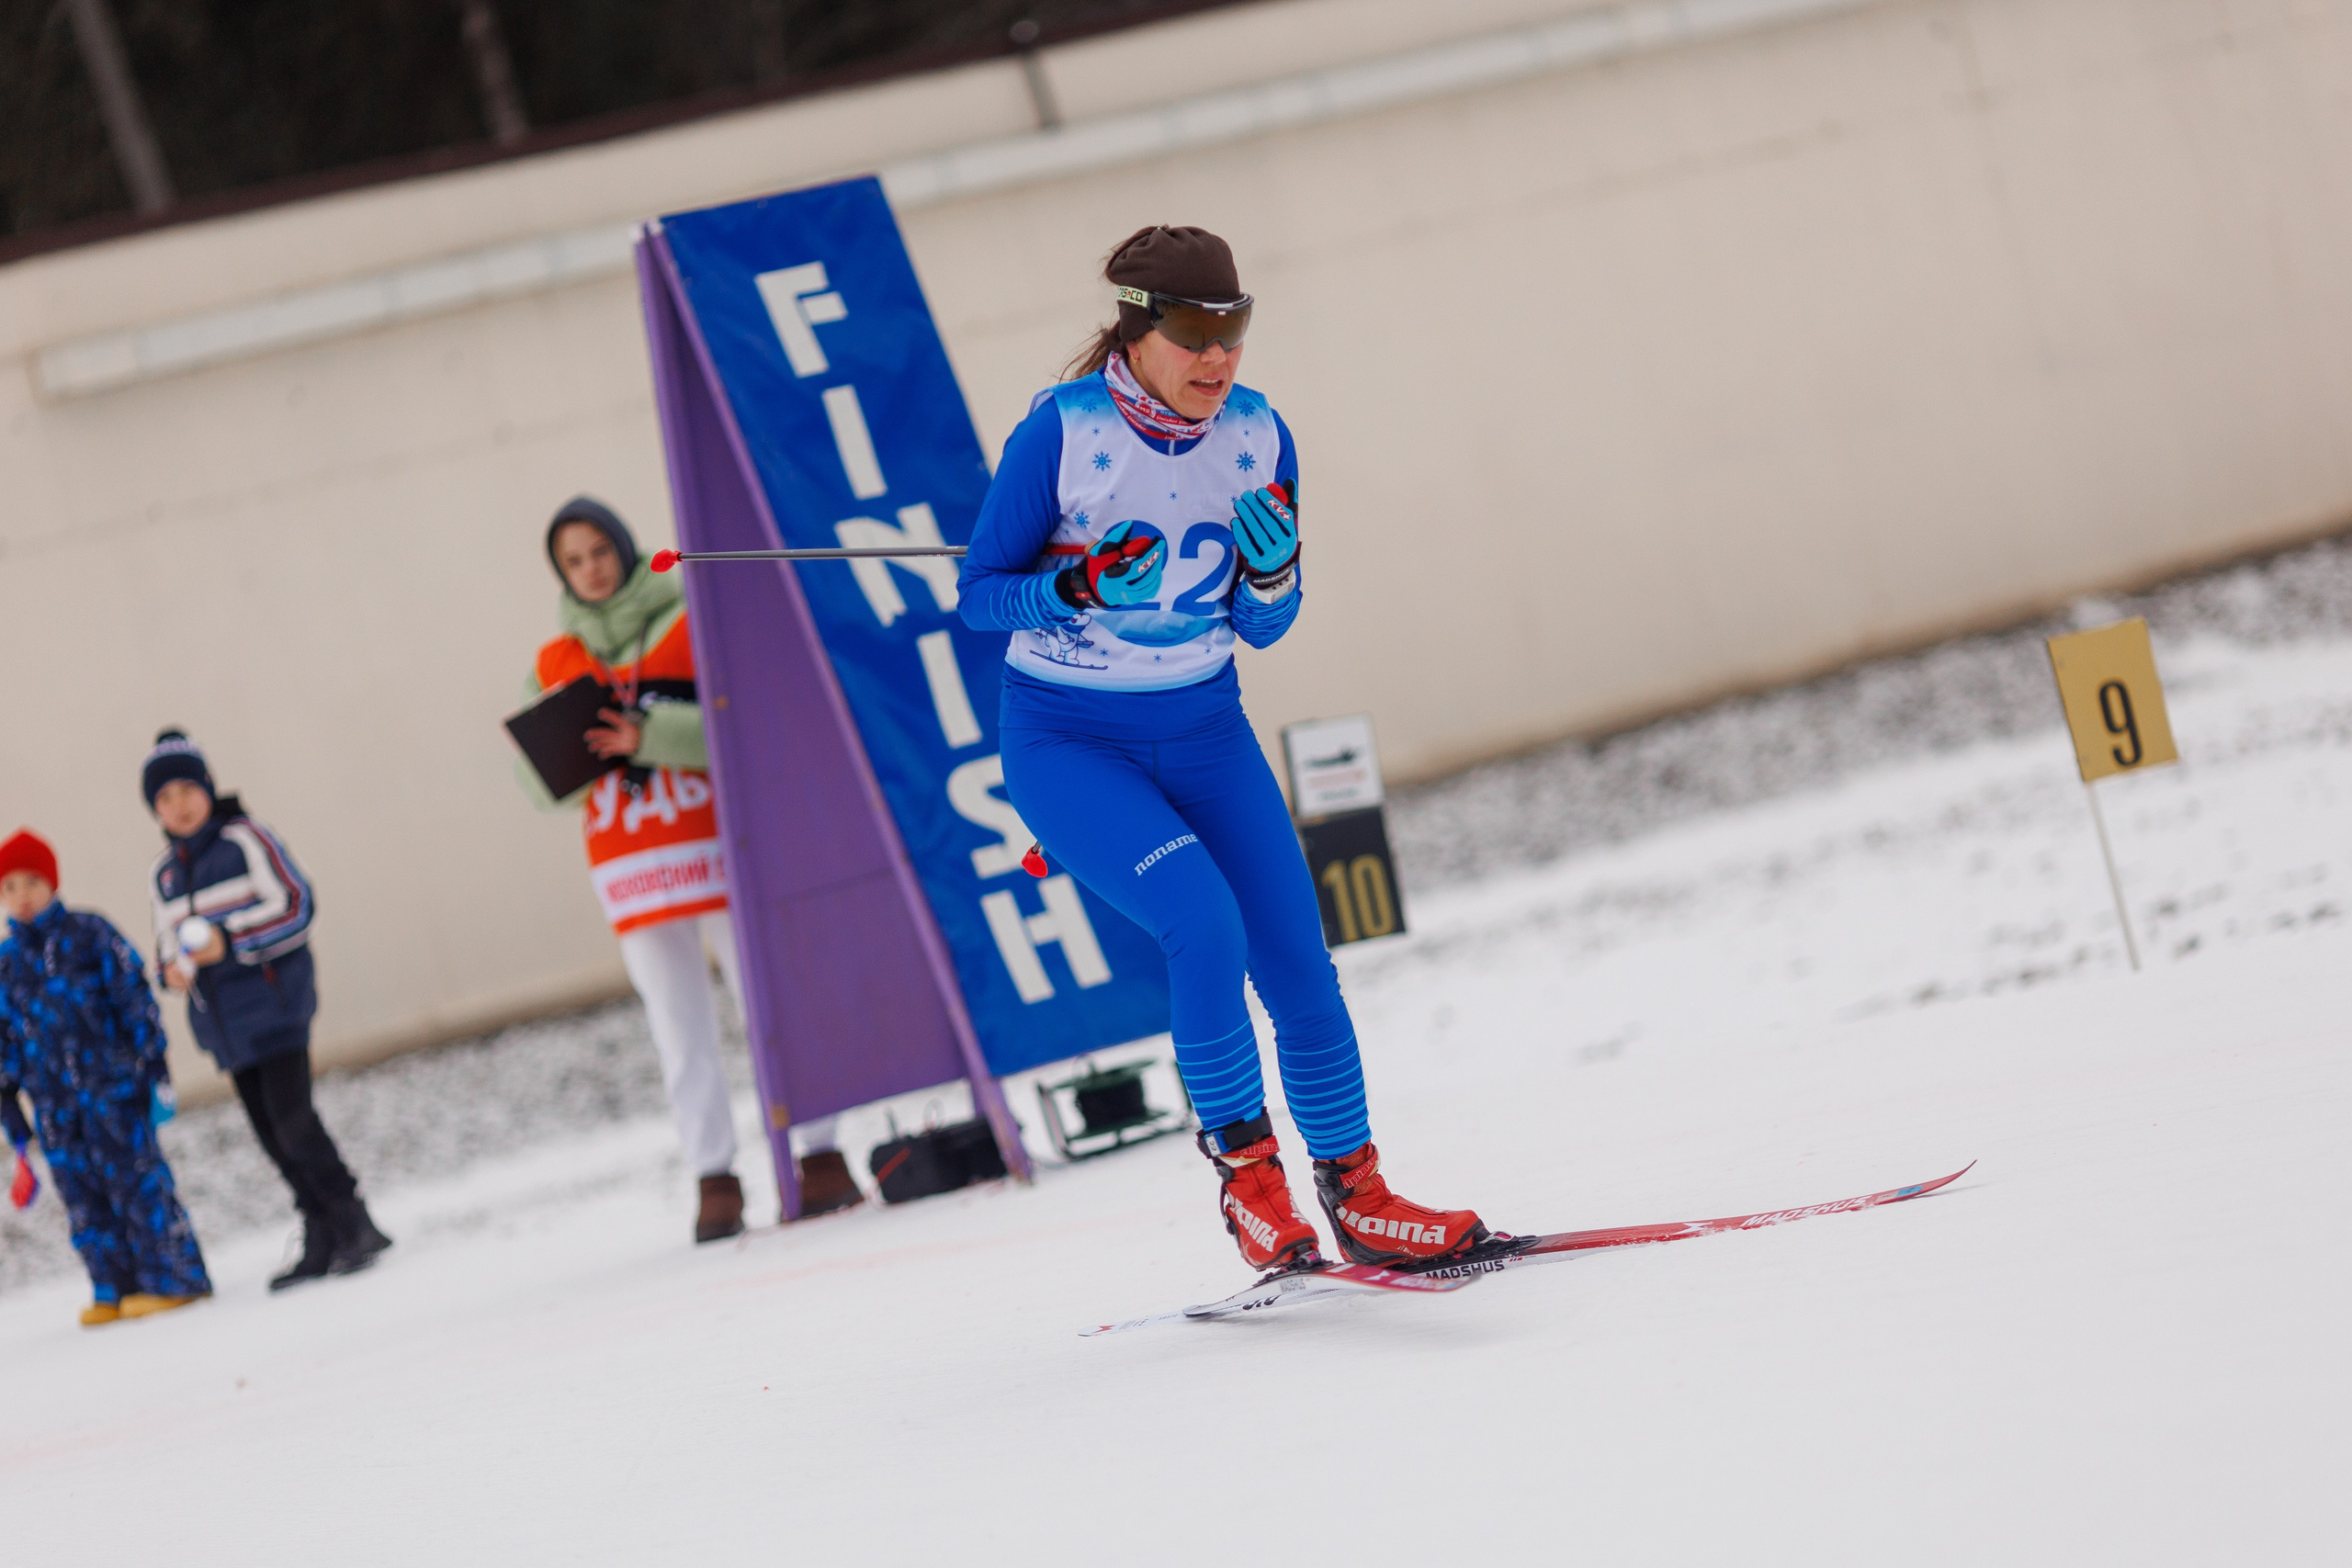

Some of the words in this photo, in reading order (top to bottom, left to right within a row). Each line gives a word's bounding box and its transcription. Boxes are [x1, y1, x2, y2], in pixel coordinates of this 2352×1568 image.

[753, 260, 1113, 1006] FINISH
[2098, 681, 2142, 766] 9
[1134, 833, 1198, 876] noname
[1321, 853, 1396, 942] 10
[1239, 1142, 1280, 1157] alpin
[1740, 1195, 1872, 1227] MADSHUS
[1425, 1259, 1505, 1280] MADSHUS
